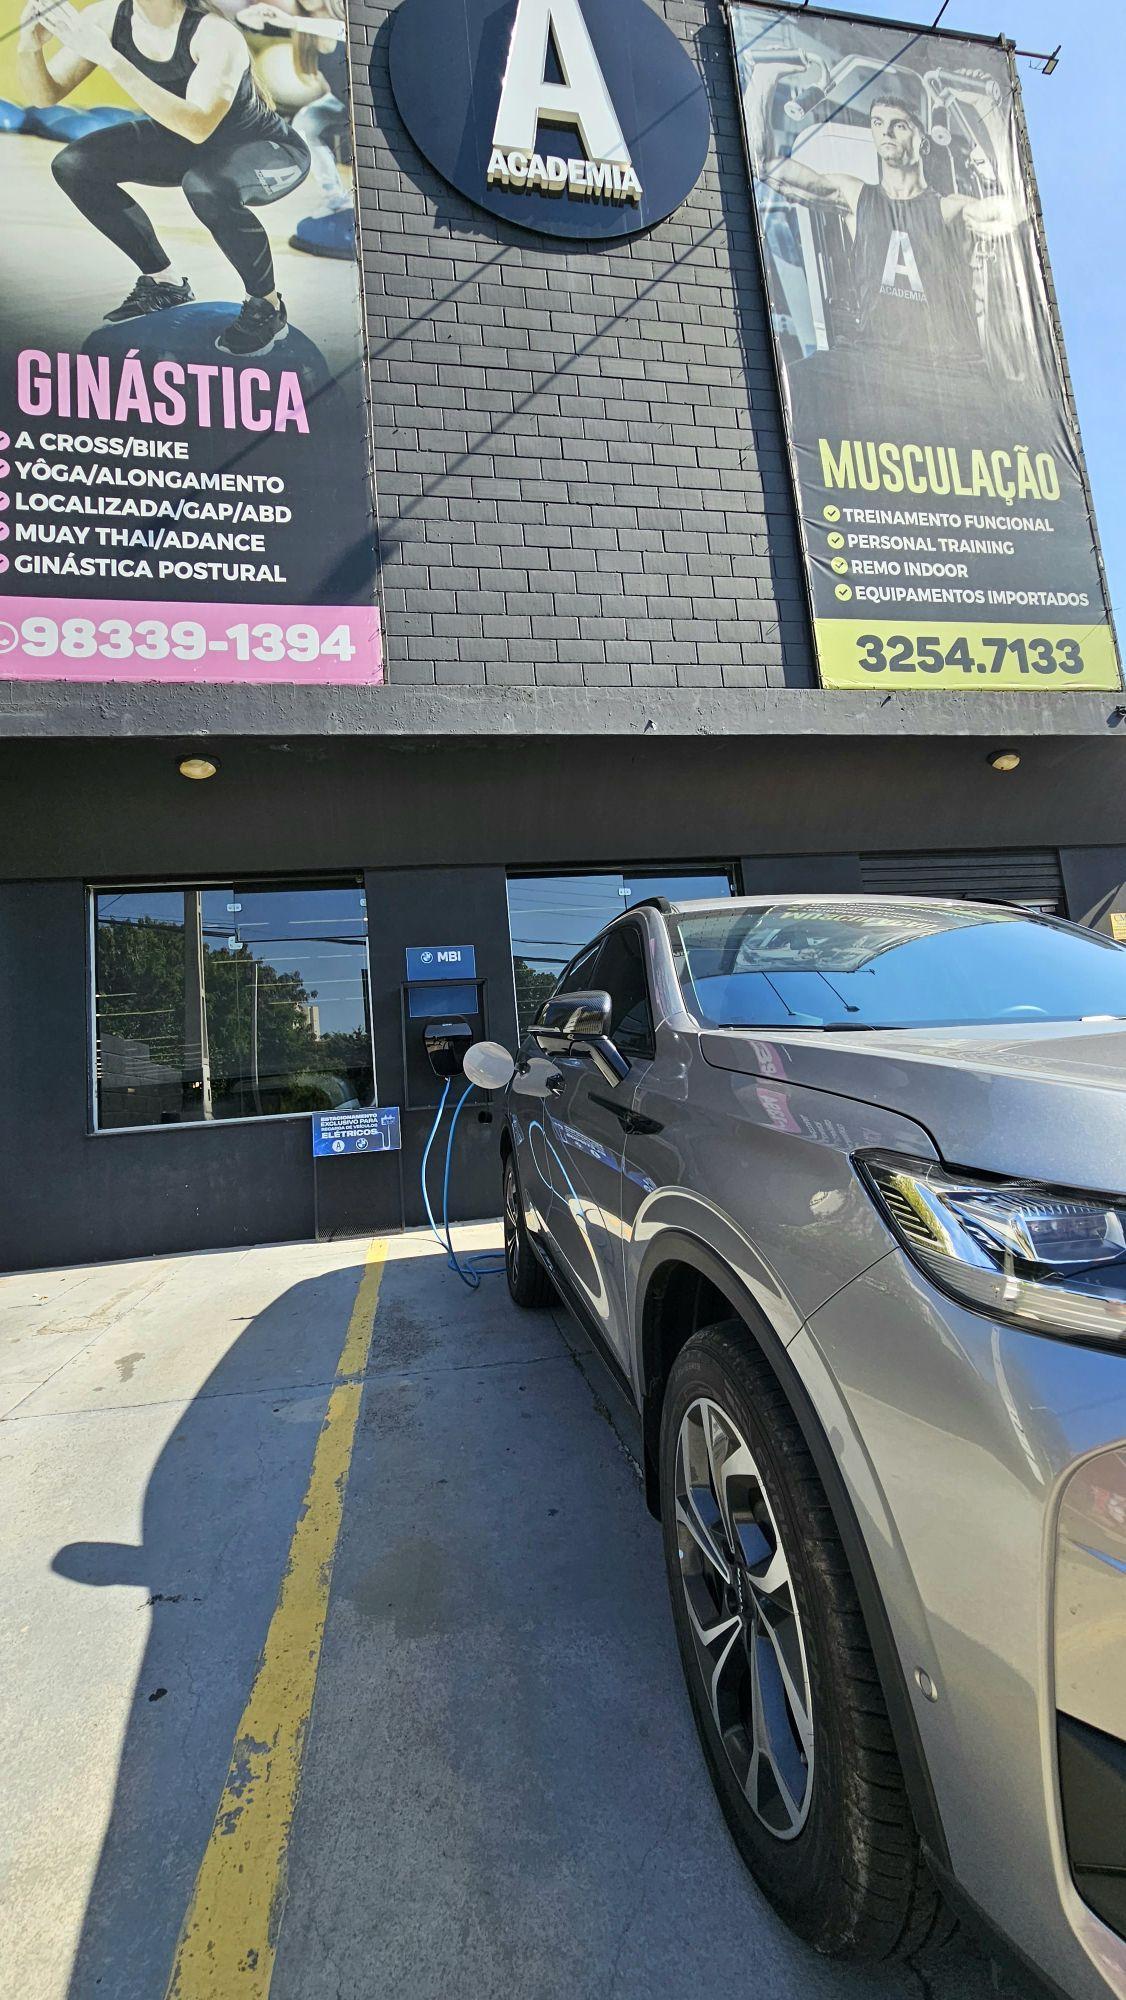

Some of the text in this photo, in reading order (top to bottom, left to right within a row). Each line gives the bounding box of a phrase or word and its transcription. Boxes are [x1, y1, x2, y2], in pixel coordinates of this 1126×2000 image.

[493, 0, 632, 164] A
[487, 148, 643, 195] ACADEMIA
[881, 229, 924, 292] A
[880, 285, 928, 302] ACADEMIA
[17, 349, 310, 434] GINÁSTICA
[15, 431, 189, 459] A CROSS/BIKE
[15, 458, 285, 494] YÔGA/ALONGAMENTO
[818, 438, 1061, 506] MUSCULAÇÃO
[15, 492, 292, 523] LOCALIZADA/GAP/ABD
[843, 508, 1054, 532] TREINAMENTO FUNCIONAL
[15, 524, 265, 552] MUAY THAI/ADANCE
[848, 534, 1015, 555] PERSONAL TRAINING
[14, 553, 287, 583] GINÁSTICA POSTURAL
[851, 559, 968, 578] REMO INDOOR
[855, 585, 1089, 607] EQUIPAMENTOS IMPORTADOS
[20, 616, 356, 662] 98339-1394
[856, 634, 1085, 674] 3254.7133
[437, 951, 462, 963] MBI
[321, 1119, 359, 1127] EXCLUSIVO
[321, 1129, 378, 1138] ELÉTRICOS
